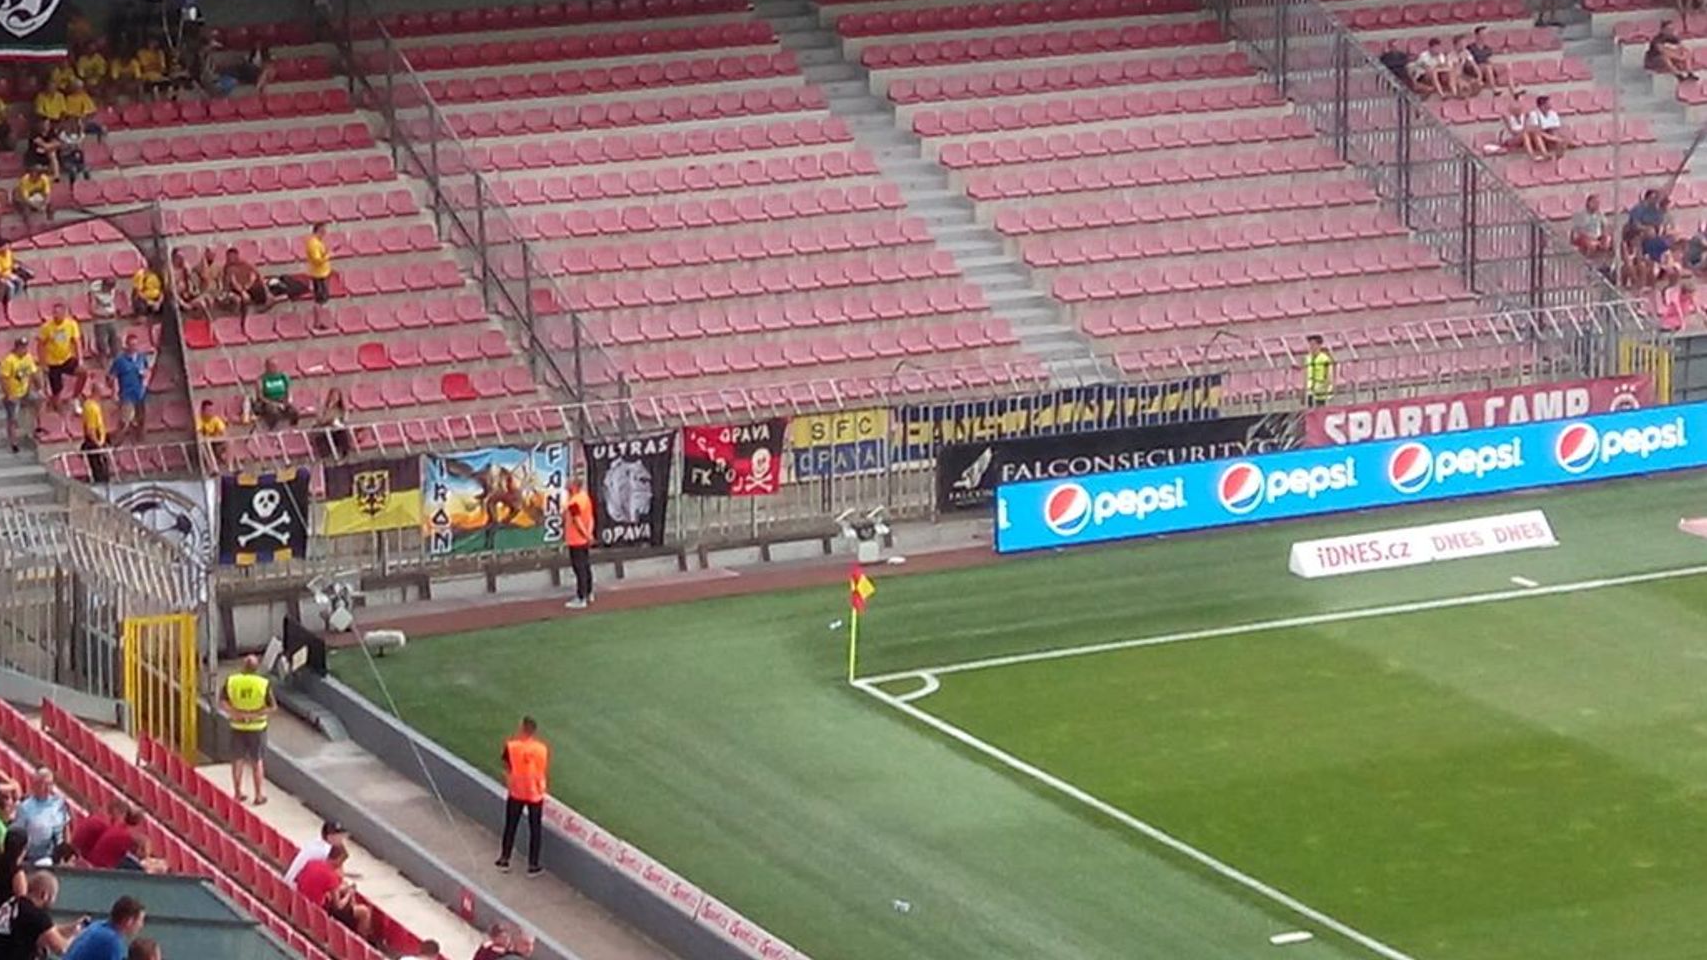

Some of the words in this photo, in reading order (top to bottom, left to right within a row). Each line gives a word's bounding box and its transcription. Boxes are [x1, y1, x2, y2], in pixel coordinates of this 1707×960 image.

[718, 424, 771, 444] OPAVA
[593, 438, 669, 458] ULTRAS
[1094, 477, 1186, 525] pepsi
[1266, 456, 1357, 504] pepsi
[1435, 436, 1523, 483] pepsi
[1599, 417, 1687, 463] pepsi
[601, 522, 652, 545] OPAVA
[1317, 540, 1412, 568] iDNES.cz
